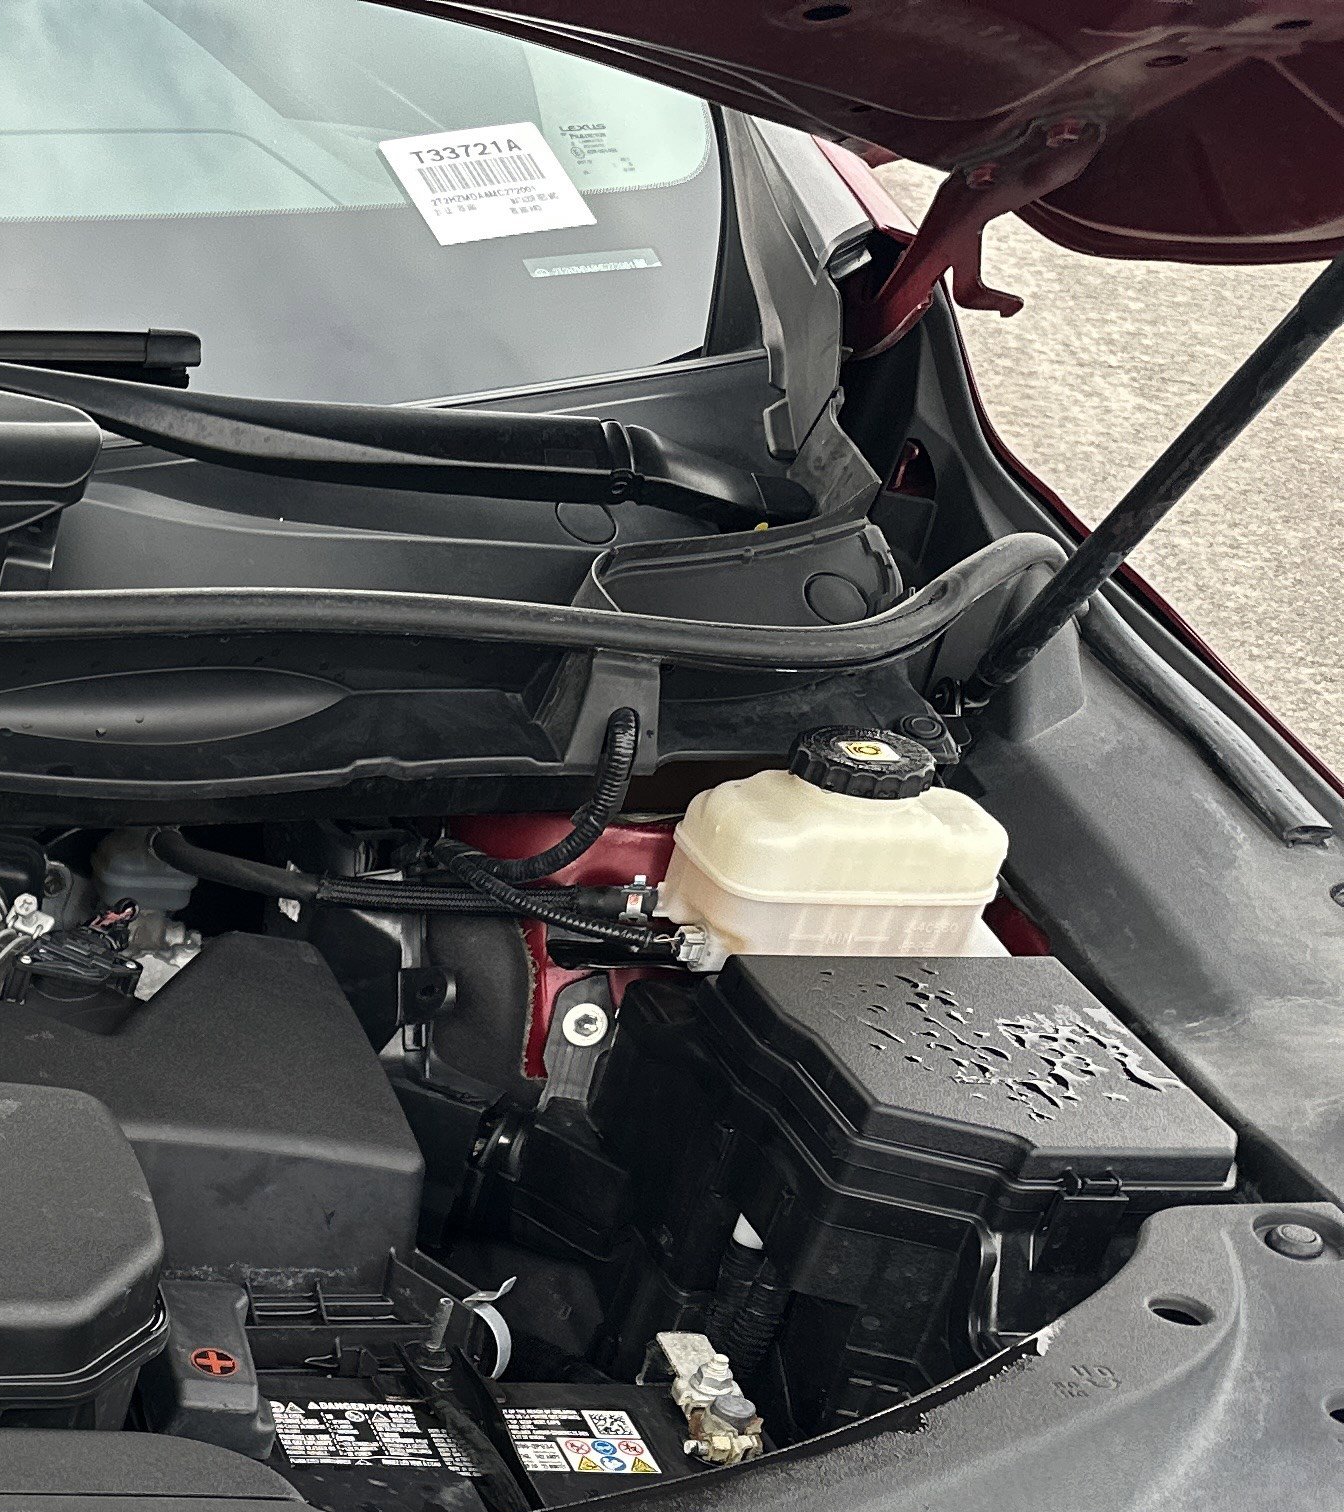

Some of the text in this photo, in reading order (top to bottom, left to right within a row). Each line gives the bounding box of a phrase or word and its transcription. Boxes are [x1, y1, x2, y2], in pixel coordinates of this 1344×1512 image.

[559, 123, 607, 132] LEXUS
[409, 138, 523, 164] T33721A
[319, 1401, 413, 1412] DANGER/POISON
